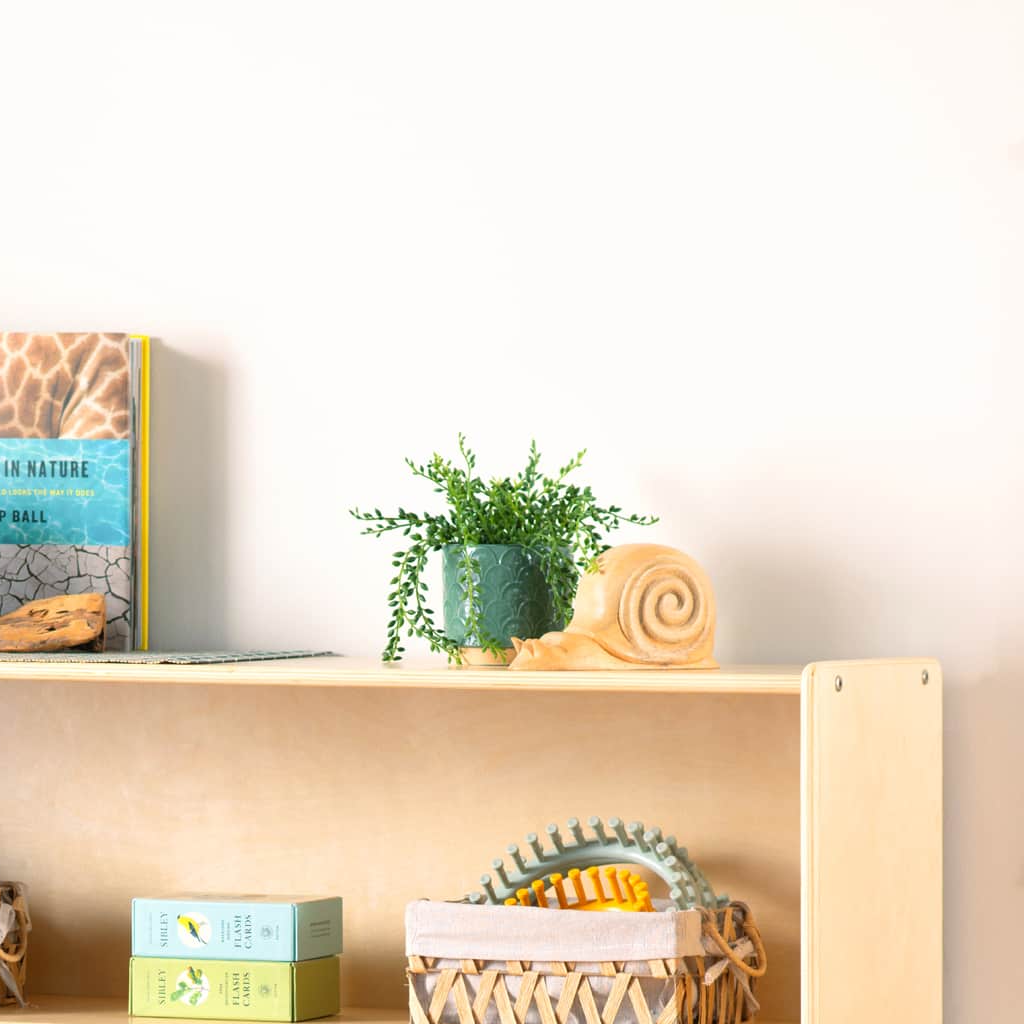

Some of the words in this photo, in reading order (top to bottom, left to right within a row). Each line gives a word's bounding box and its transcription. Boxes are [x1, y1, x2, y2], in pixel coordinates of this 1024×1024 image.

[4, 460, 21, 478] IN
[27, 460, 89, 479] NATURE
[49, 488, 65, 497] WAY
[66, 488, 74, 497] IT
[12, 510, 48, 524] BALL
[159, 911, 169, 948] SIBLEY
[234, 914, 242, 949] FLASH
[244, 914, 252, 950] CARDS
[158, 968, 167, 1006] SIBLEY
[232, 972, 240, 1007] FLASH
[243, 971, 251, 1007] CARDS
